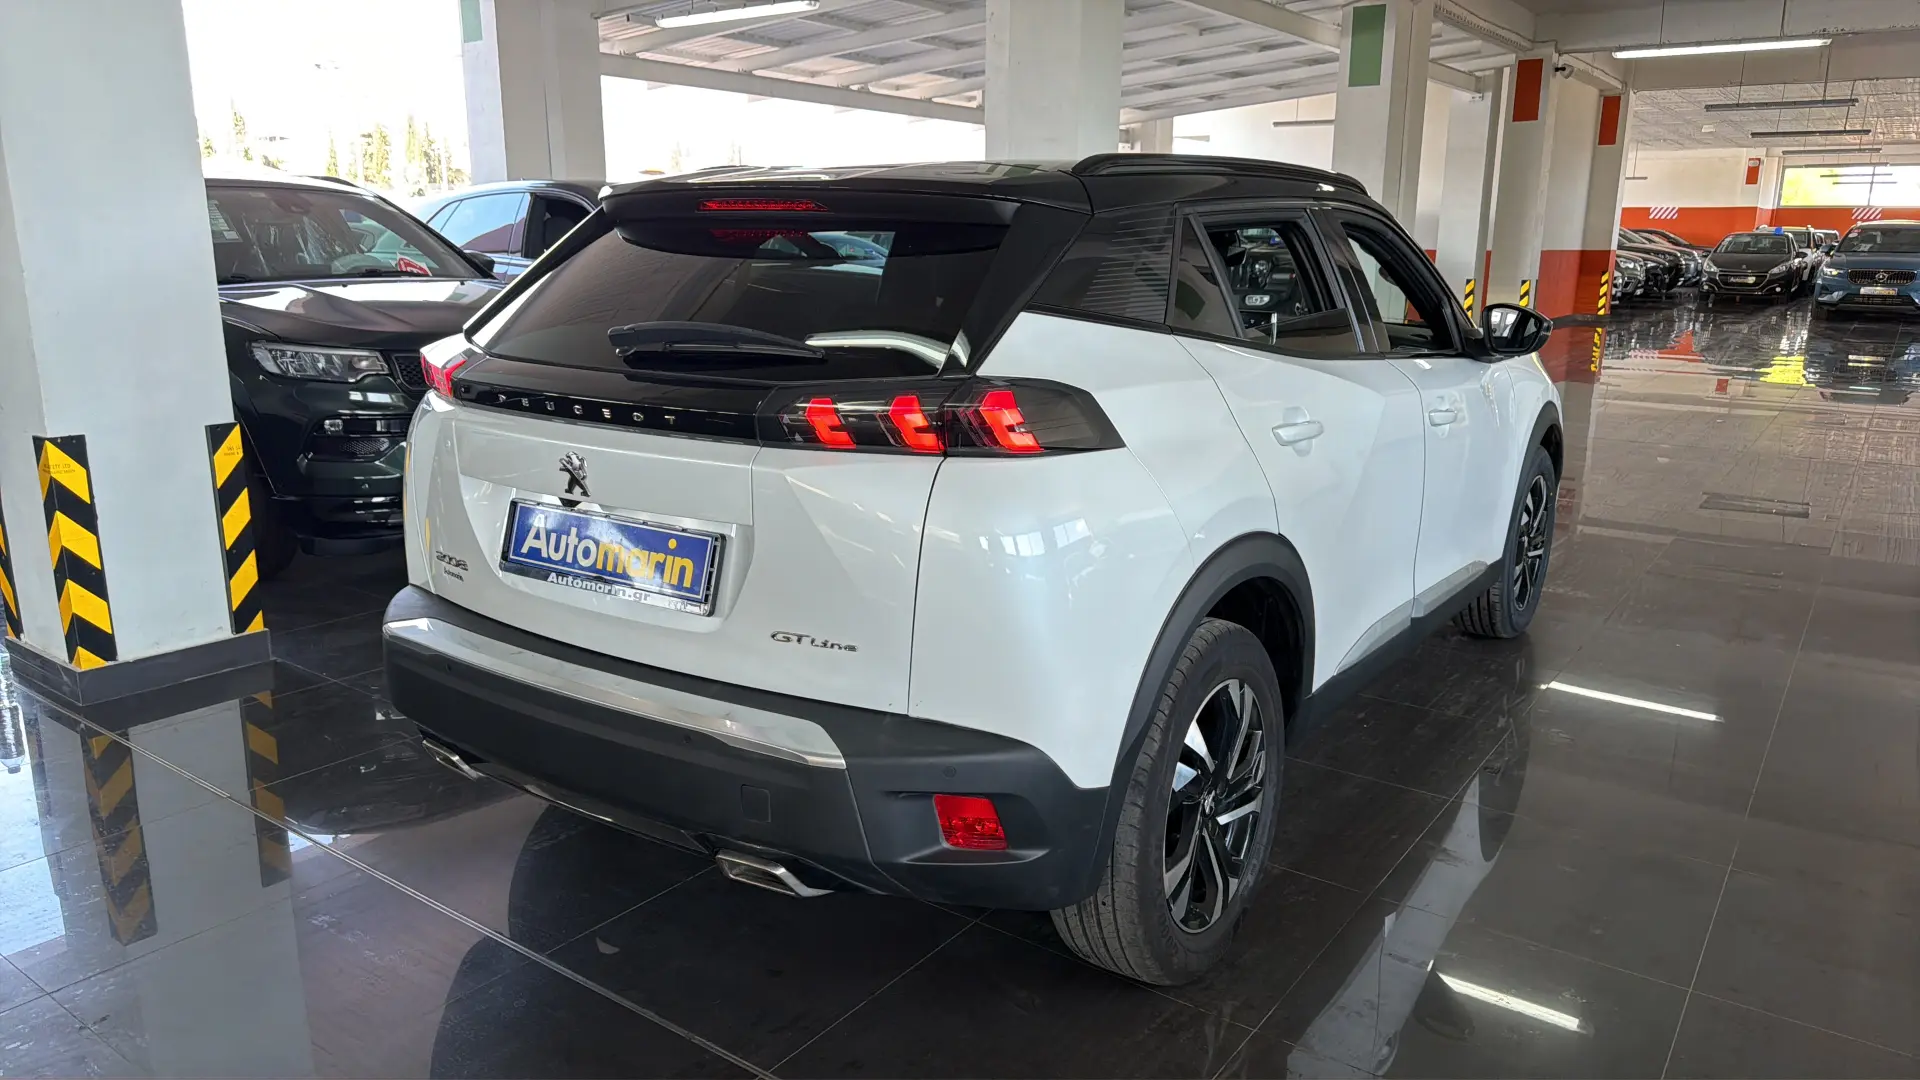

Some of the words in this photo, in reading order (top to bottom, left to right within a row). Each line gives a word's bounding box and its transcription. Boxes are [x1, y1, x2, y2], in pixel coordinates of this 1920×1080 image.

[497, 393, 676, 425] PEUGEOT
[435, 550, 469, 572] 2008
[520, 513, 695, 588] Automarin
[547, 572, 651, 603] Automarin.gr
